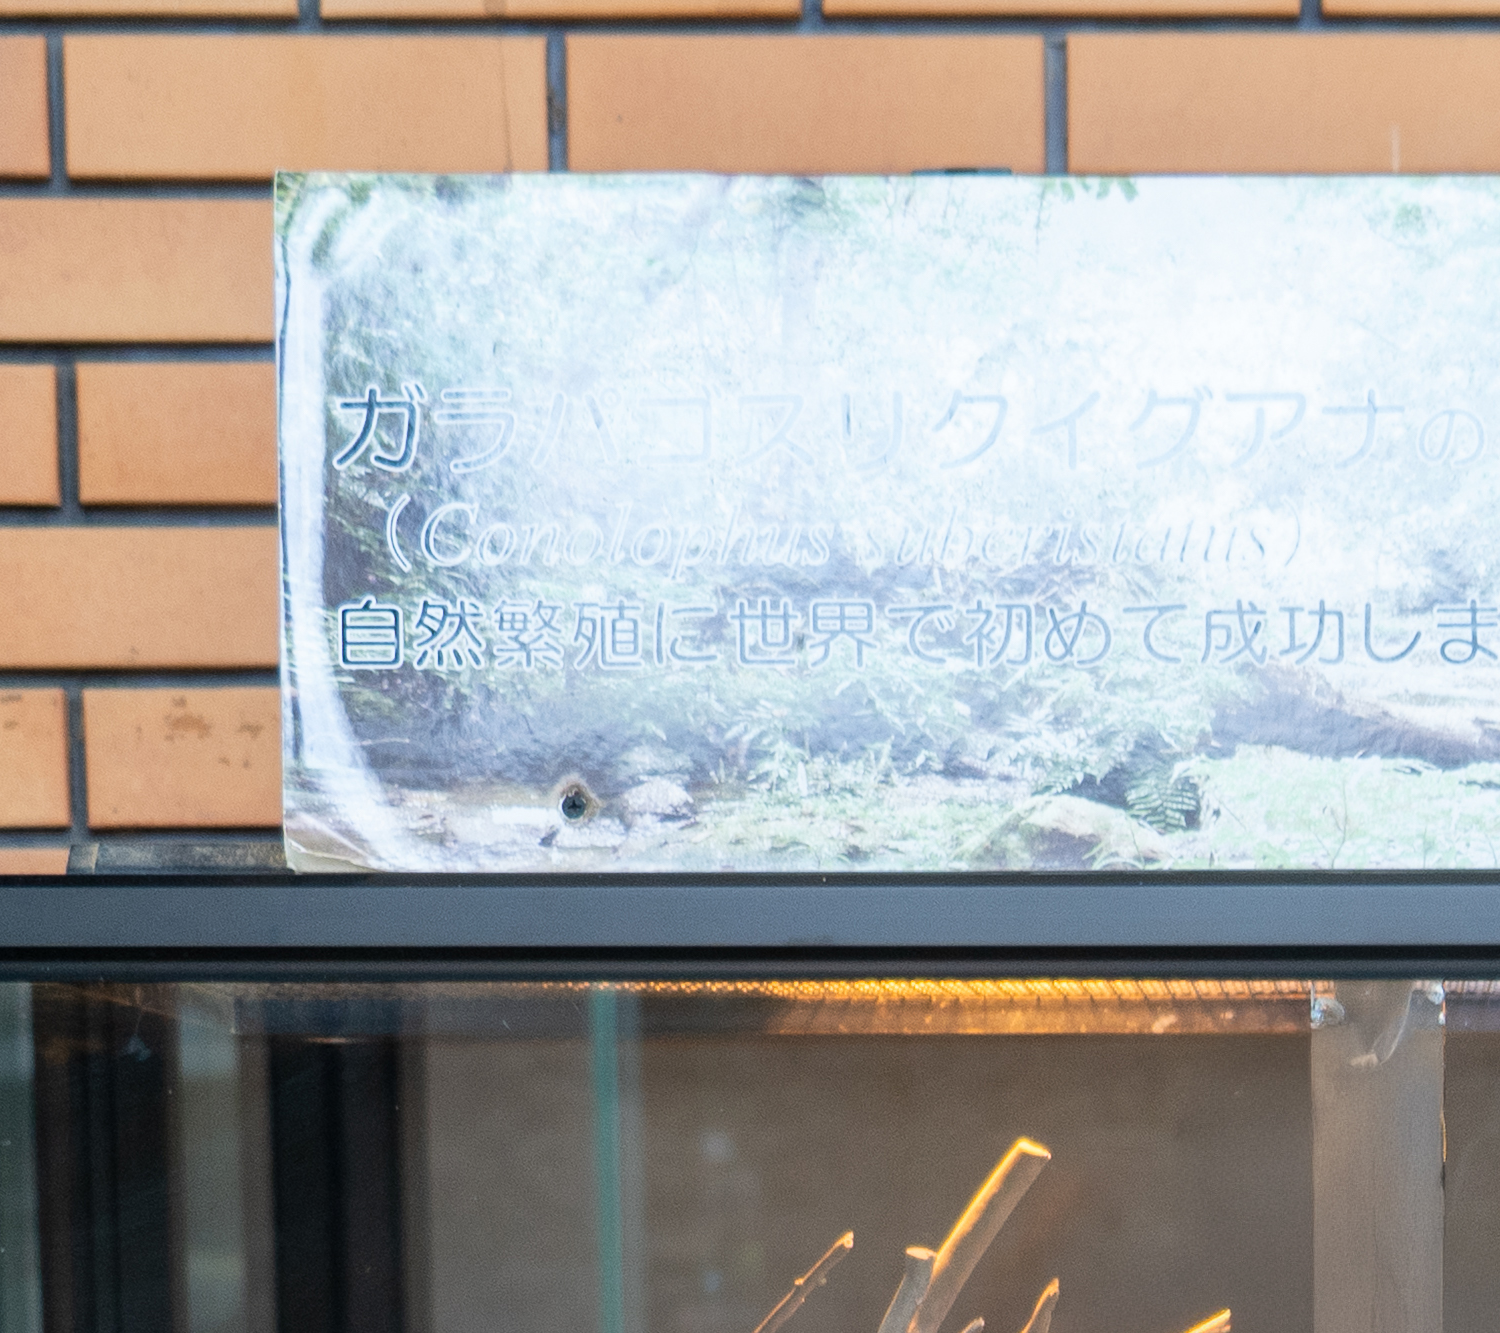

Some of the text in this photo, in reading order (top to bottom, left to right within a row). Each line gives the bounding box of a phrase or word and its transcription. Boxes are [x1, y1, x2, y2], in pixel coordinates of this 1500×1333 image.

[335, 384, 1487, 472] ガラパゴスリクイグアナの
